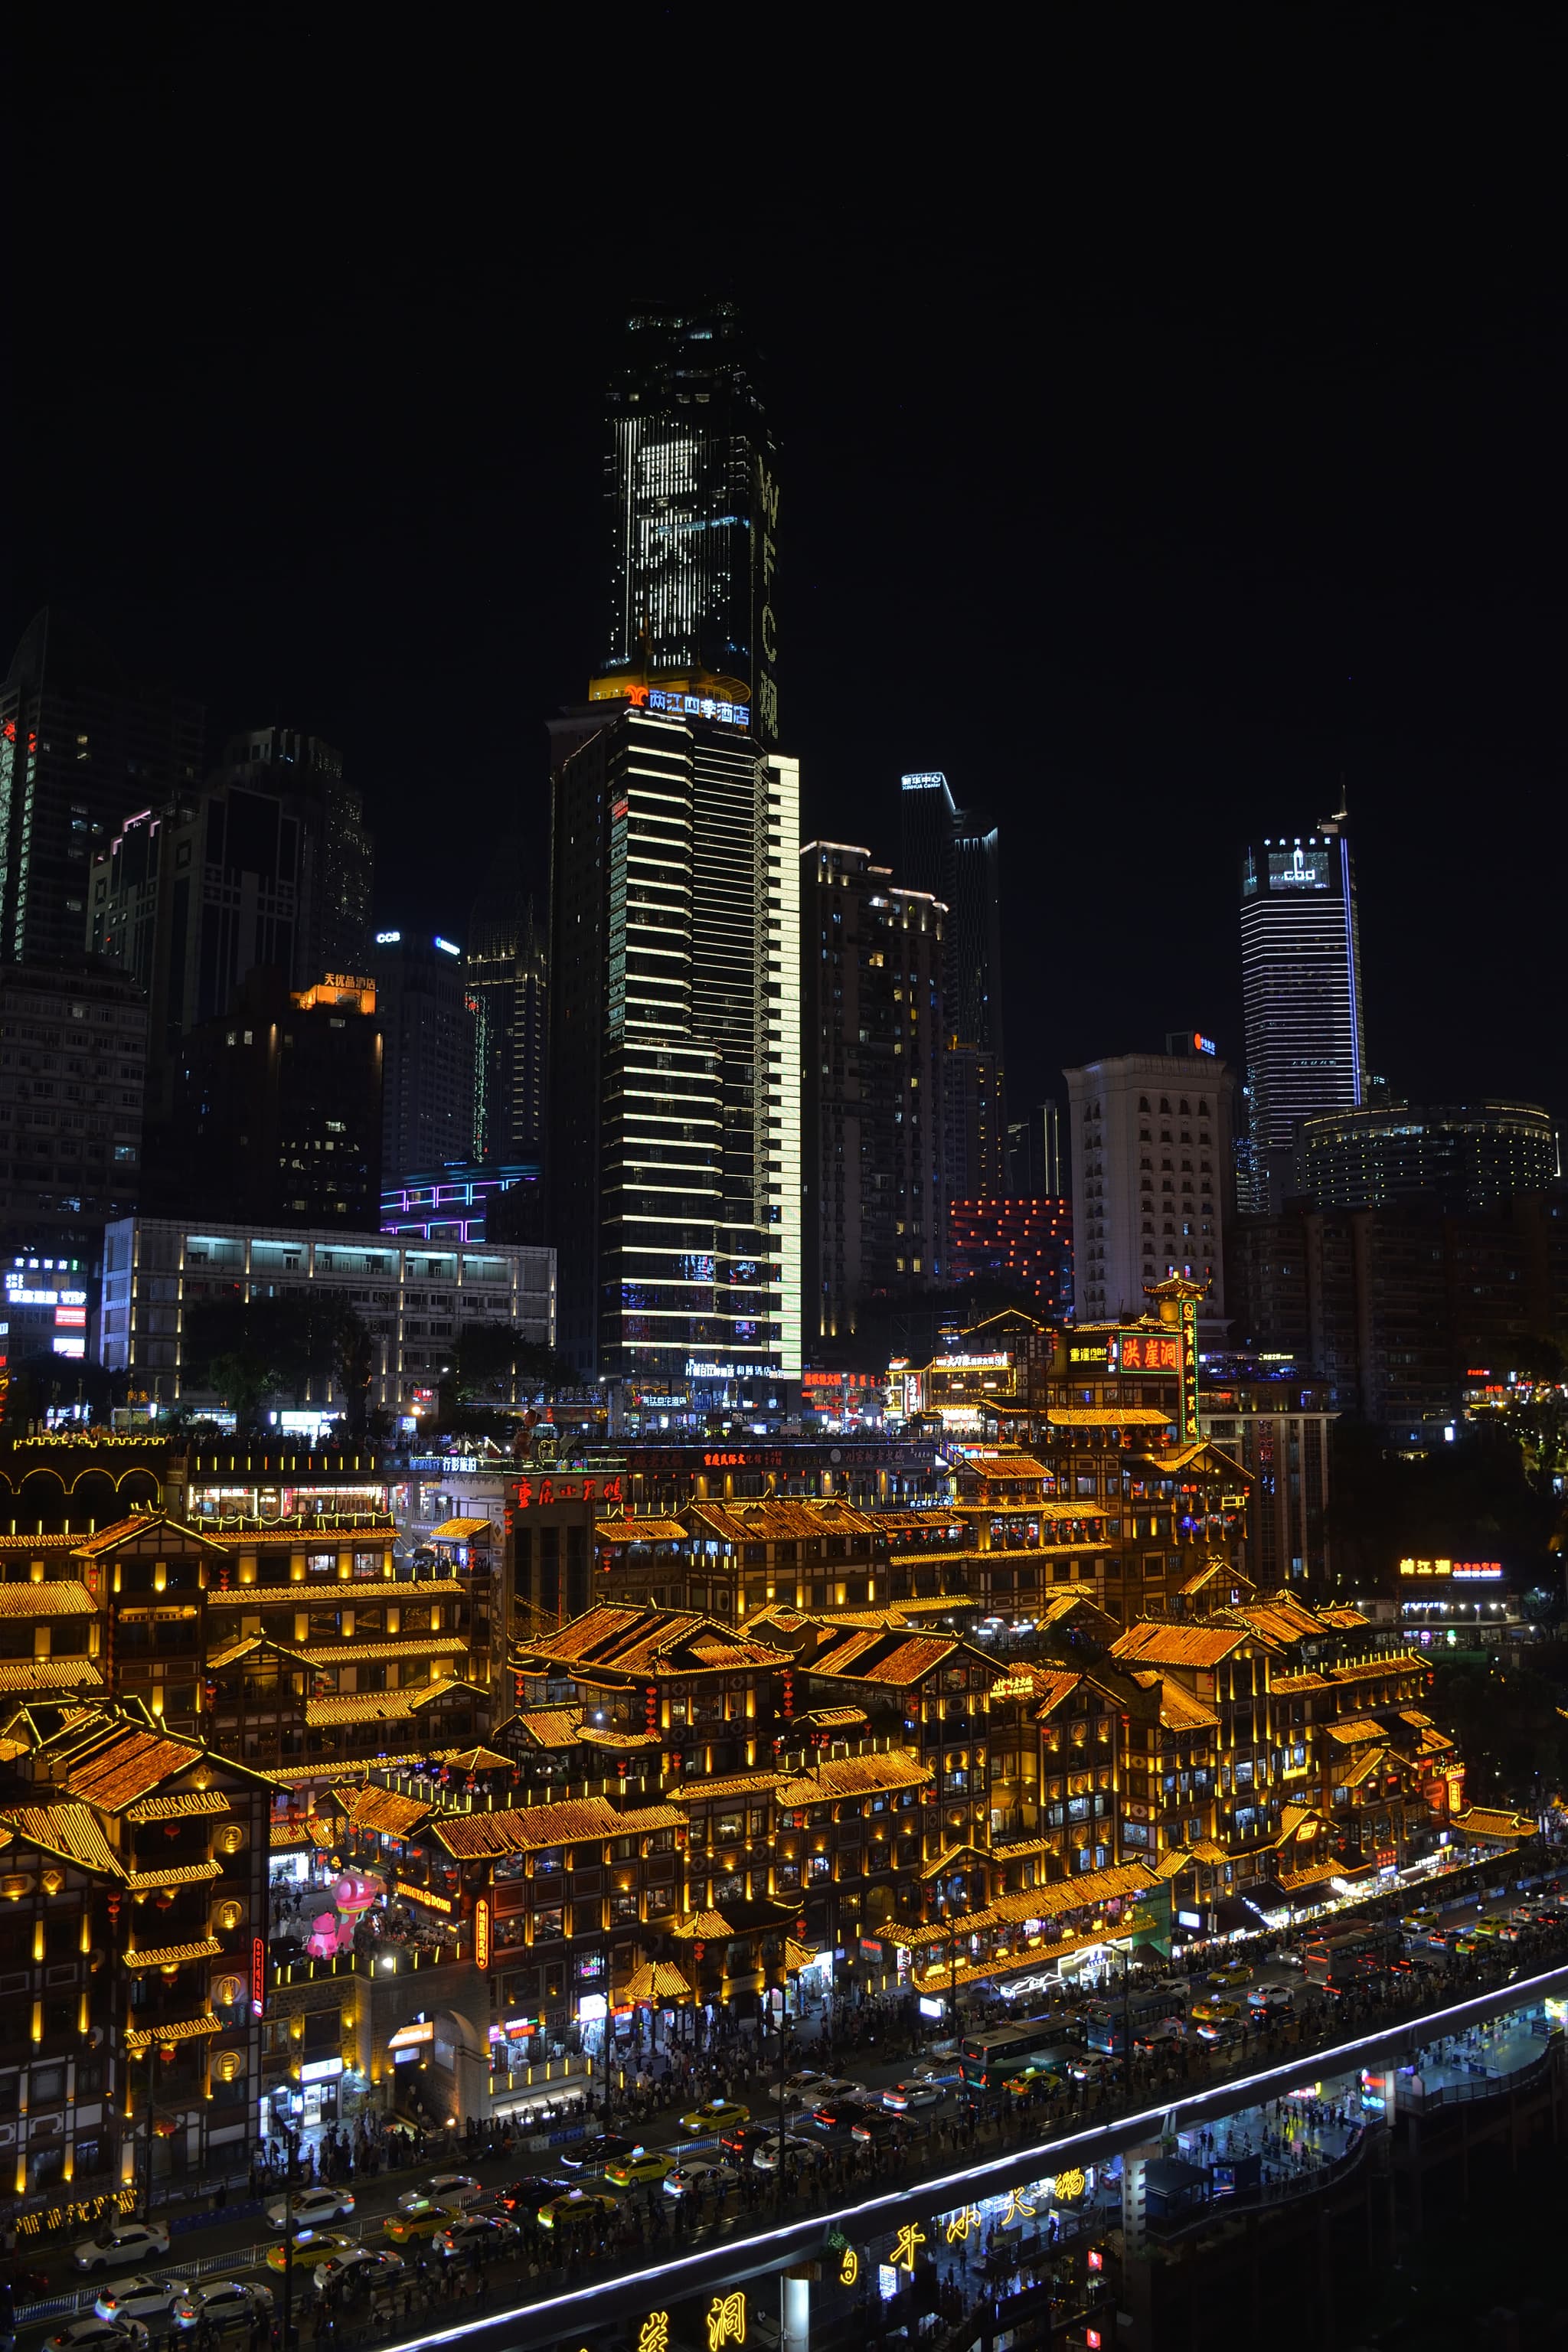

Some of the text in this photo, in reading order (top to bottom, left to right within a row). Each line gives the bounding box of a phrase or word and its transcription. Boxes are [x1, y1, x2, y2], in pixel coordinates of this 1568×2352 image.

[649, 689, 750, 726] 两江四季酒店
[902, 775, 941, 786] 新华中心
[376, 932, 400, 944] CCB
[1122, 1338, 1177, 1369] 洪崖洞
[737, 1365, 771, 1377] 和颐酒店
[1184, 1325, 1197, 1435] 重庆小天鹅
[512, 1476, 623, 1509] 重庆小天鹅
[397, 1882, 451, 1913] HONGYA DONG
